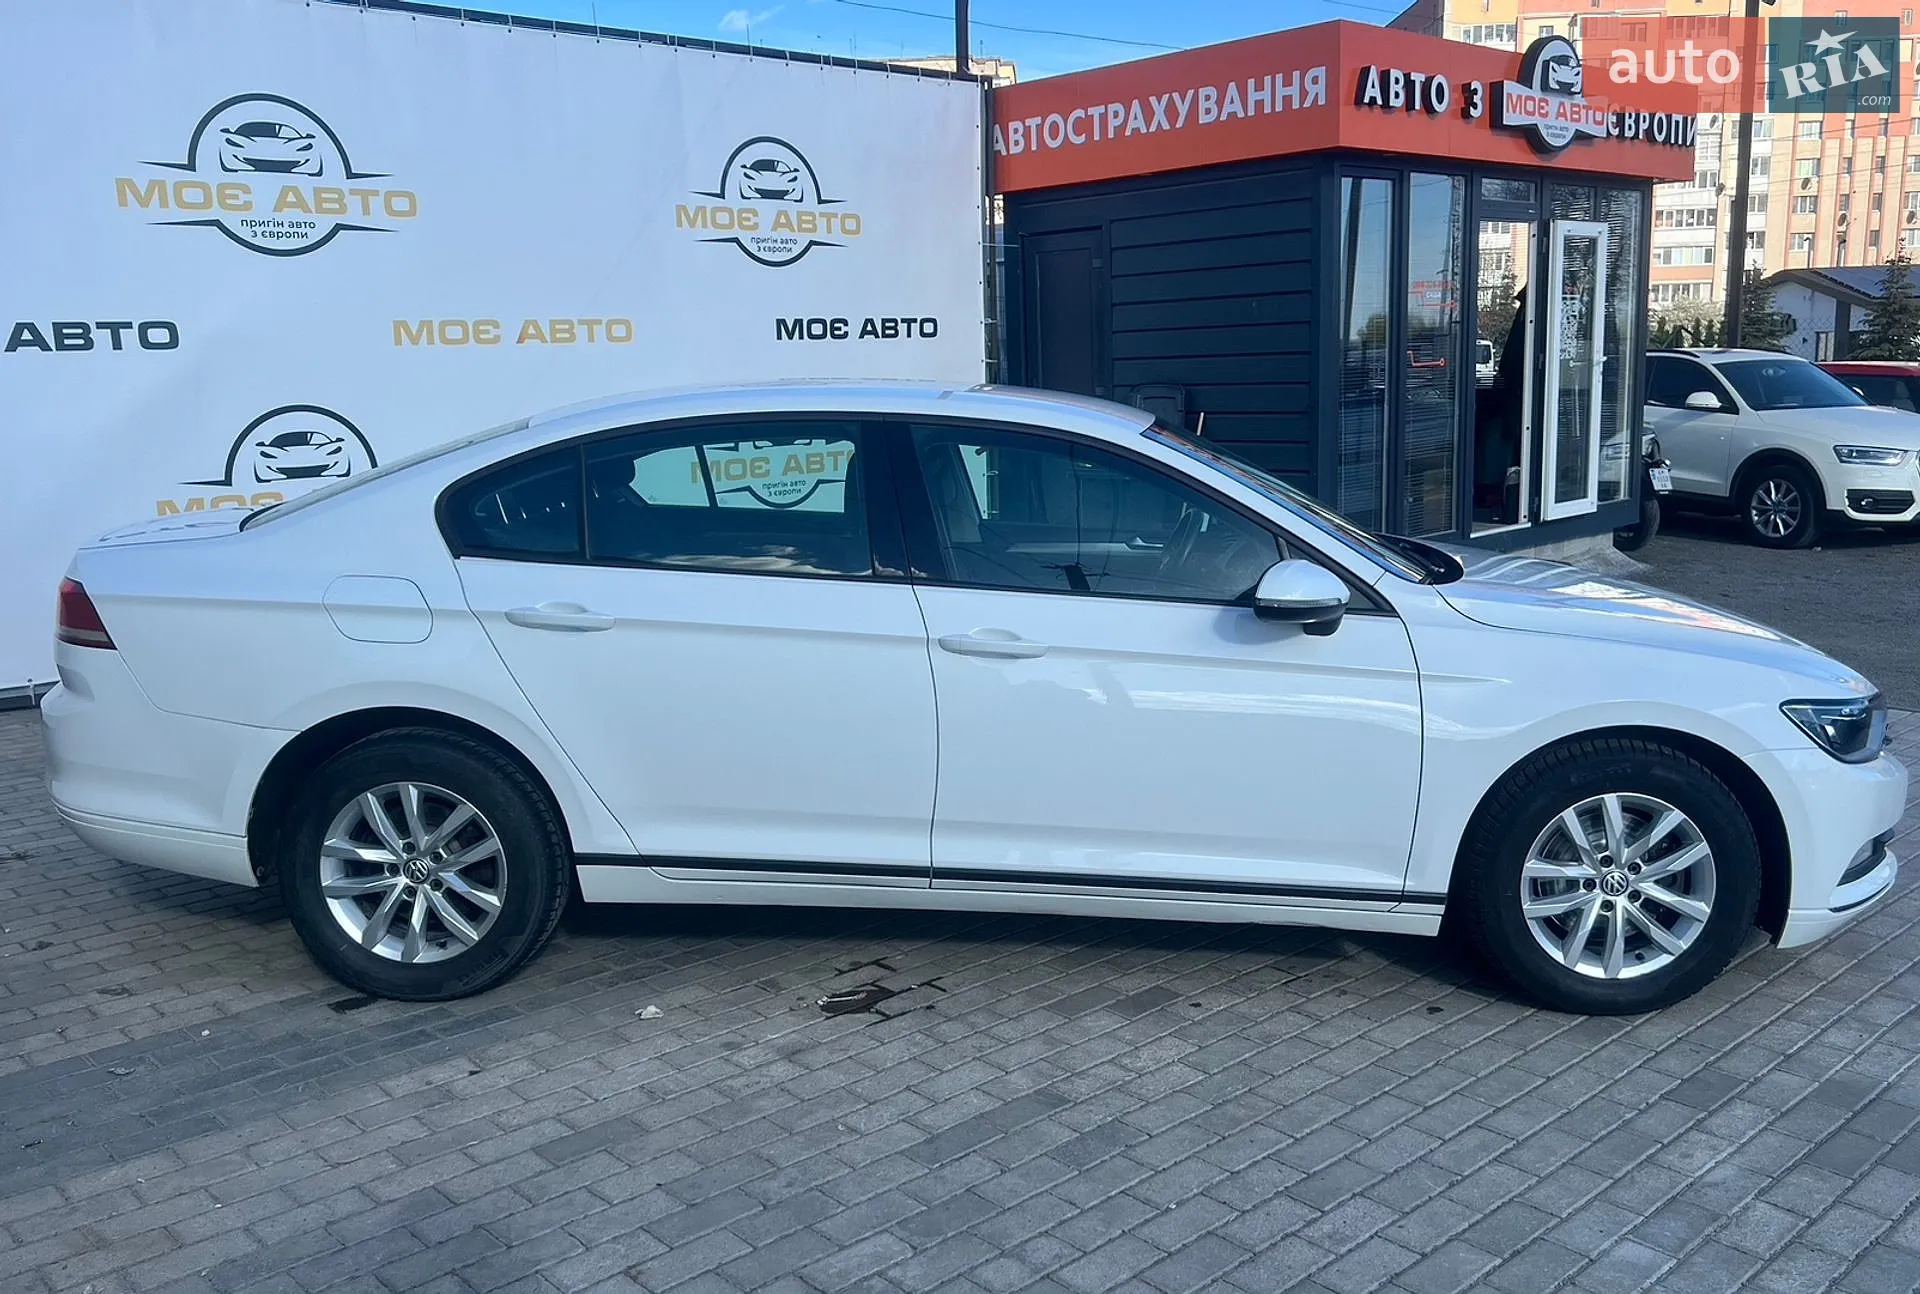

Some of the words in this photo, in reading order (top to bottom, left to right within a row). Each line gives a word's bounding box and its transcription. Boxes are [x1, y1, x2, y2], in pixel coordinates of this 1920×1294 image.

[1361, 64, 1450, 114] АВТО
[993, 65, 1327, 156] АВТОСТРАХУВАННЯ
[1505, 92, 1550, 119] МОЄ
[1555, 101, 1605, 127] АВТО
[1607, 103, 1698, 146] ЄВРОПИ
[115, 177, 253, 212] МОЄ
[272, 184, 417, 218] АВТО
[240, 217, 284, 230] пригін
[287, 220, 316, 230] авто
[261, 230, 309, 240] європи
[675, 204, 760, 231] МОЄ
[771, 209, 862, 235] АВТО
[4, 321, 179, 351] АВТО
[393, 319, 501, 345] МОЄ
[516, 318, 633, 344] АВТО
[775, 318, 849, 340] МОЄ
[858, 317, 938, 339] АВТО
